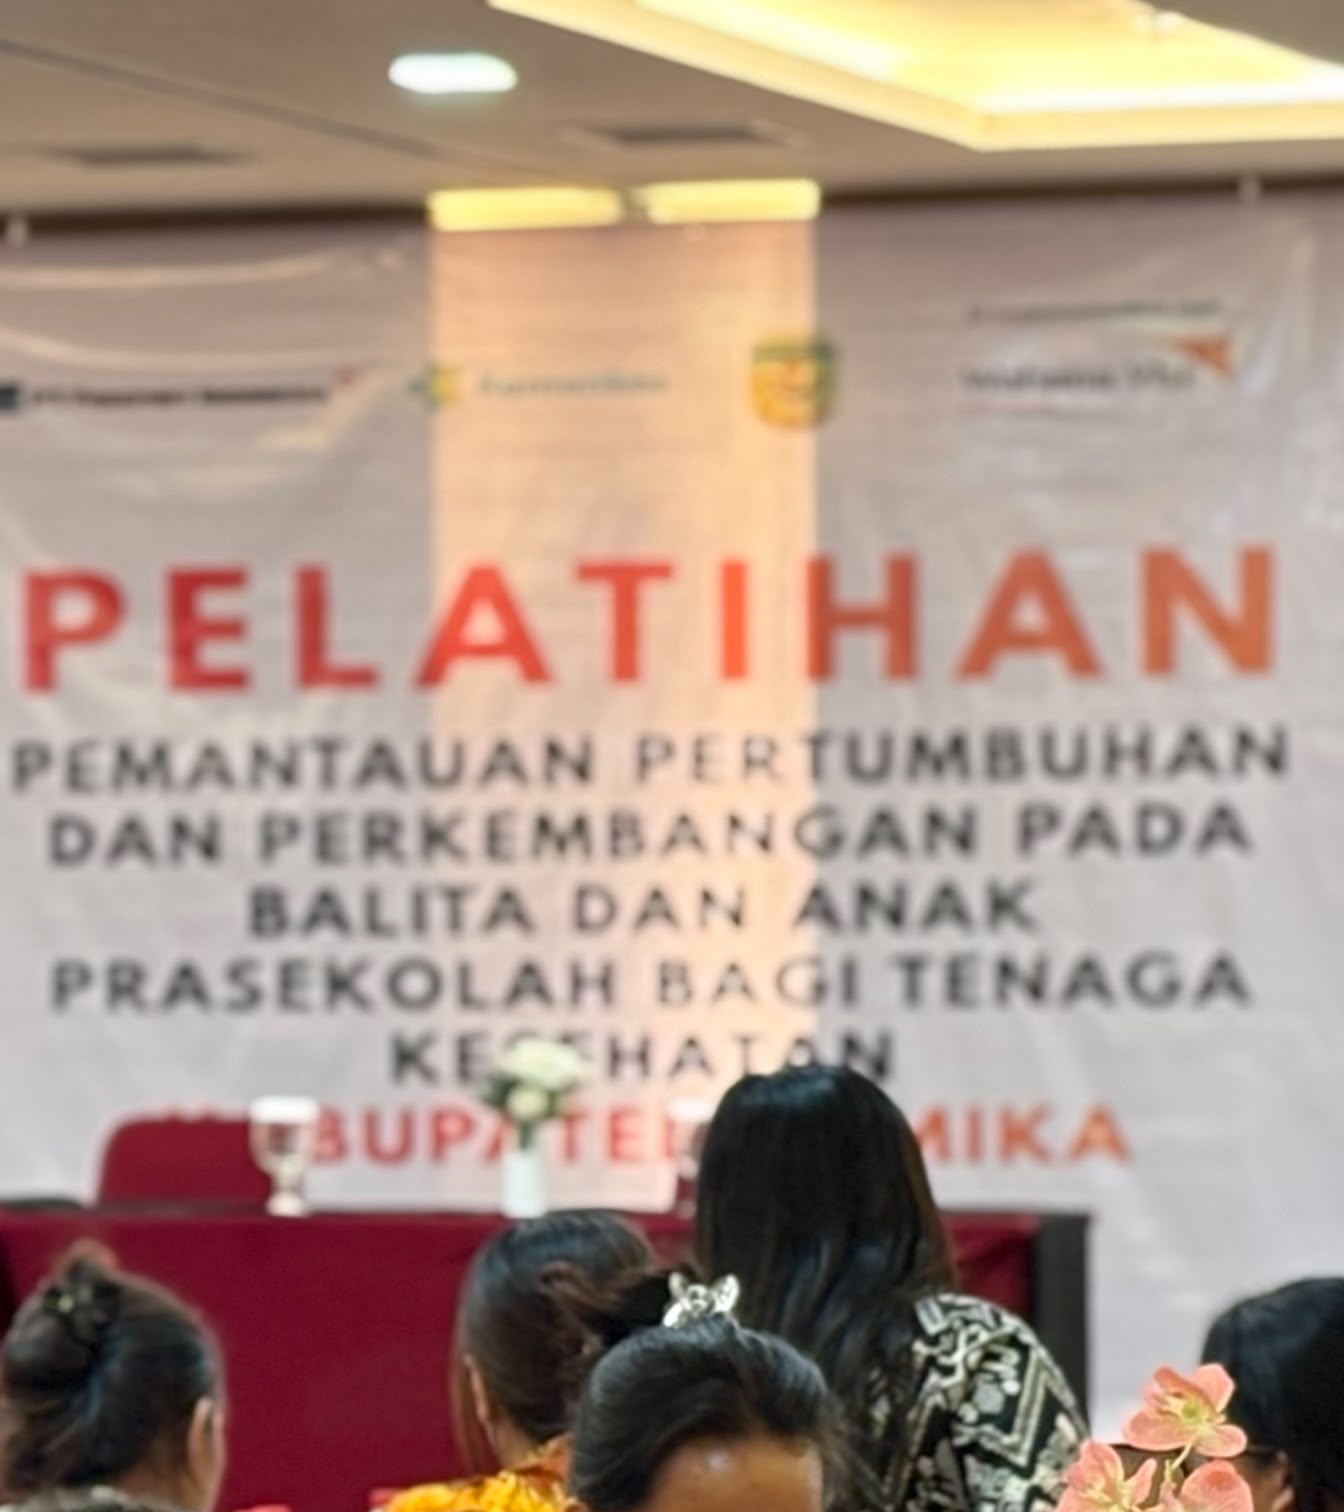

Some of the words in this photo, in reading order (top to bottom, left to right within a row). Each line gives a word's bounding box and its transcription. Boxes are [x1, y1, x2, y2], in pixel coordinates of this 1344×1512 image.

[22, 546, 1274, 691] PELATIHAN
[13, 737, 594, 795] PEMANTAUAN
[636, 727, 1290, 784] PERTUMBUHAN
[50, 812, 224, 866] DAN
[262, 806, 978, 866] PERKEMBANGAN
[1020, 803, 1252, 858] PADA
[250, 885, 537, 940] BALITA
[575, 885, 744, 935] DAN
[794, 880, 1036, 935] ANAK
[53, 958, 616, 1012] PRASEKOLAH
[659, 957, 856, 1008] BAGI
[896, 953, 1254, 1008] TENAGA
[393, 1030, 892, 1086] KEHATAN
